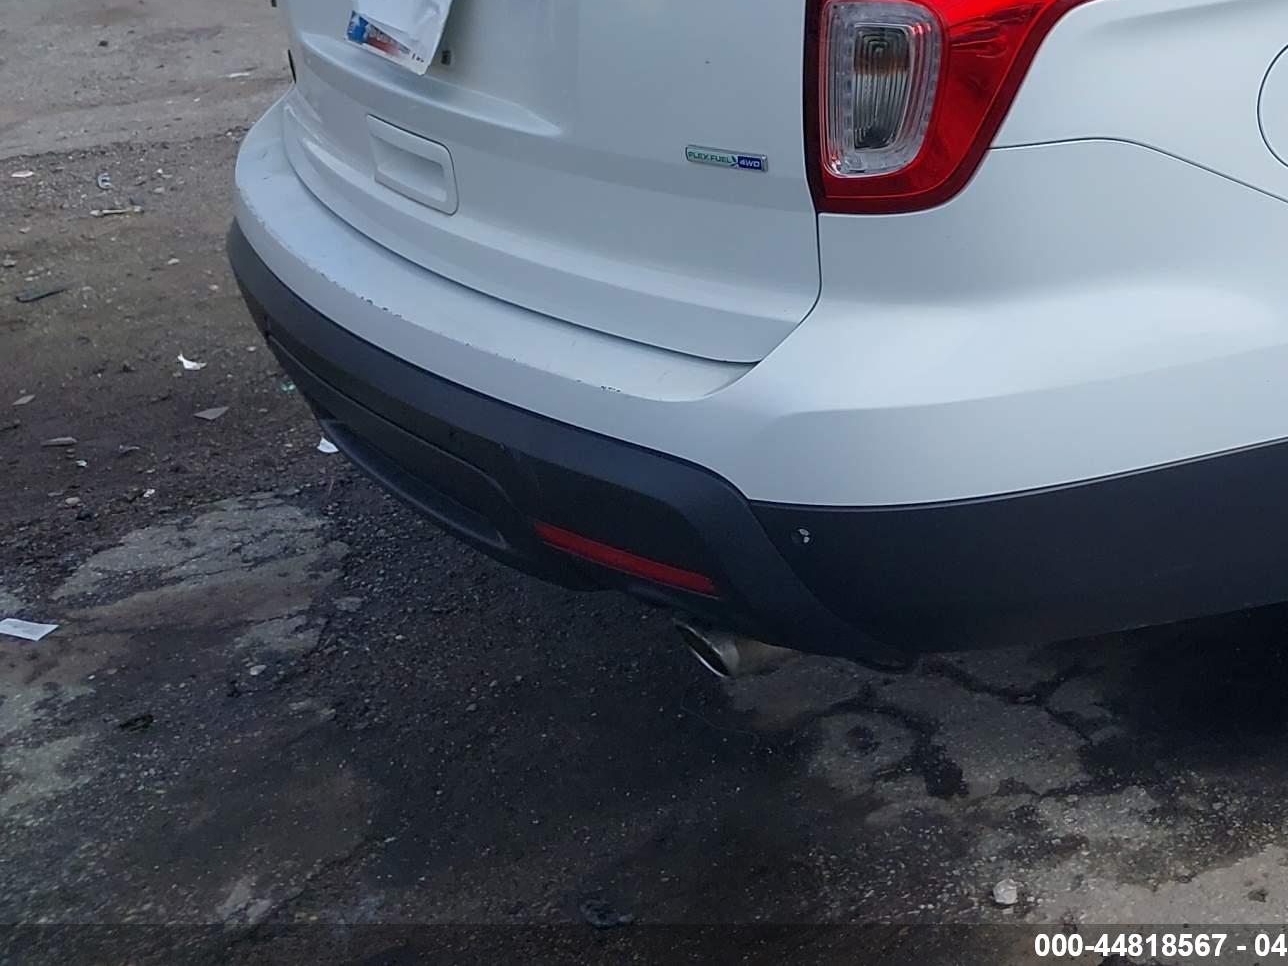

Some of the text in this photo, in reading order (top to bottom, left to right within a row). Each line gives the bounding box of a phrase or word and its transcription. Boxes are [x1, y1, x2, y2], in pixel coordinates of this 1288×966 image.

[687, 151, 760, 168] FLEX FUEL 4WD
